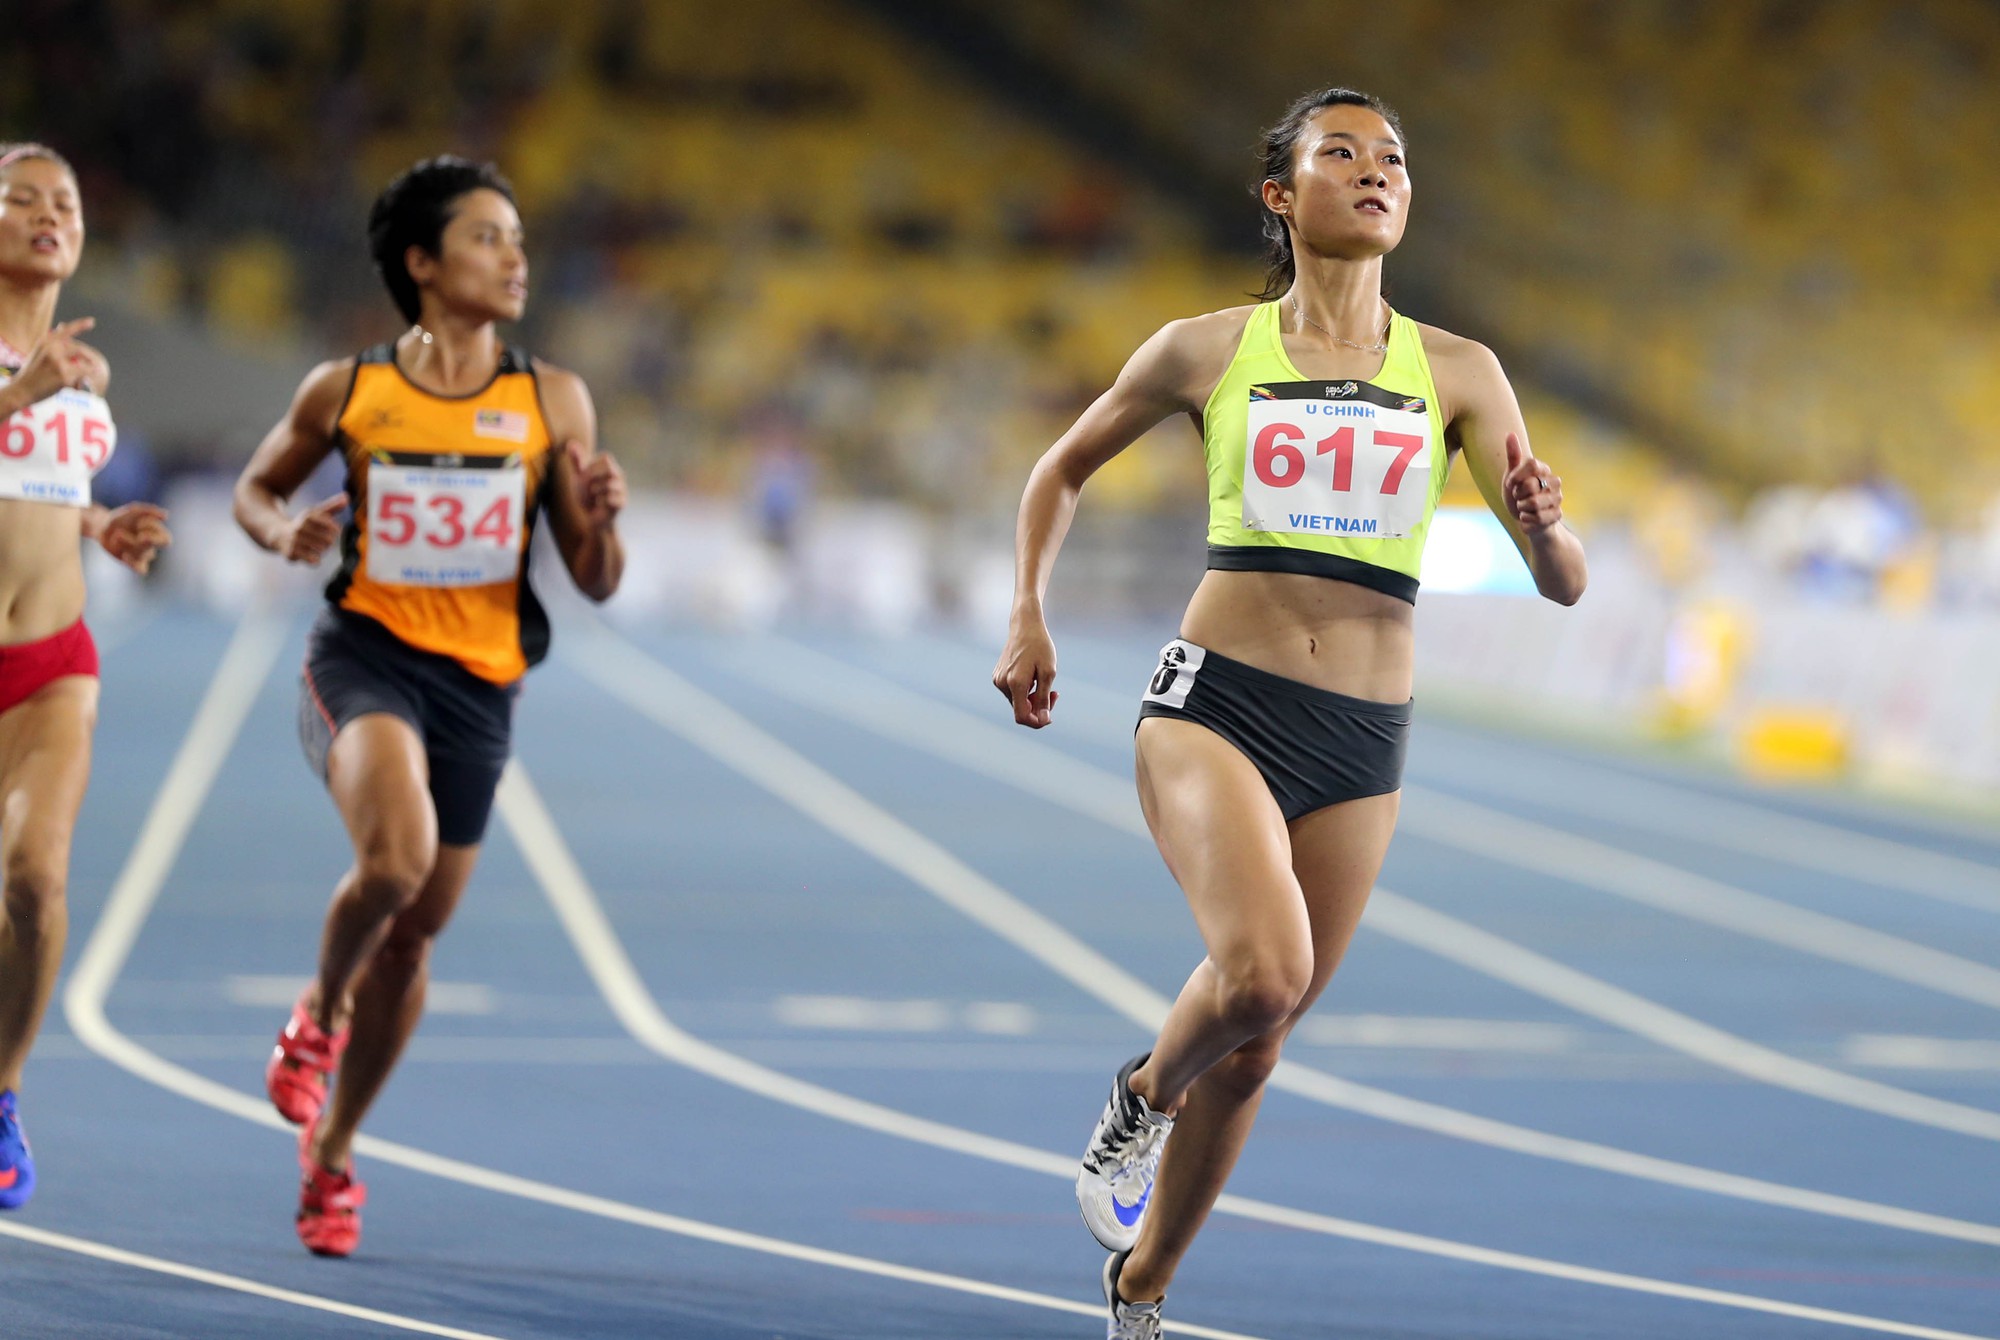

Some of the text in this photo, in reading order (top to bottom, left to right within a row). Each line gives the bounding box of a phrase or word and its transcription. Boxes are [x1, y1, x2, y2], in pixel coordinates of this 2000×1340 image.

[0, 406, 109, 470] 615
[1305, 404, 1376, 418] U CHINH
[1252, 422, 1424, 496] 617
[376, 493, 514, 548] 534
[1288, 513, 1378, 533] VIETNAM
